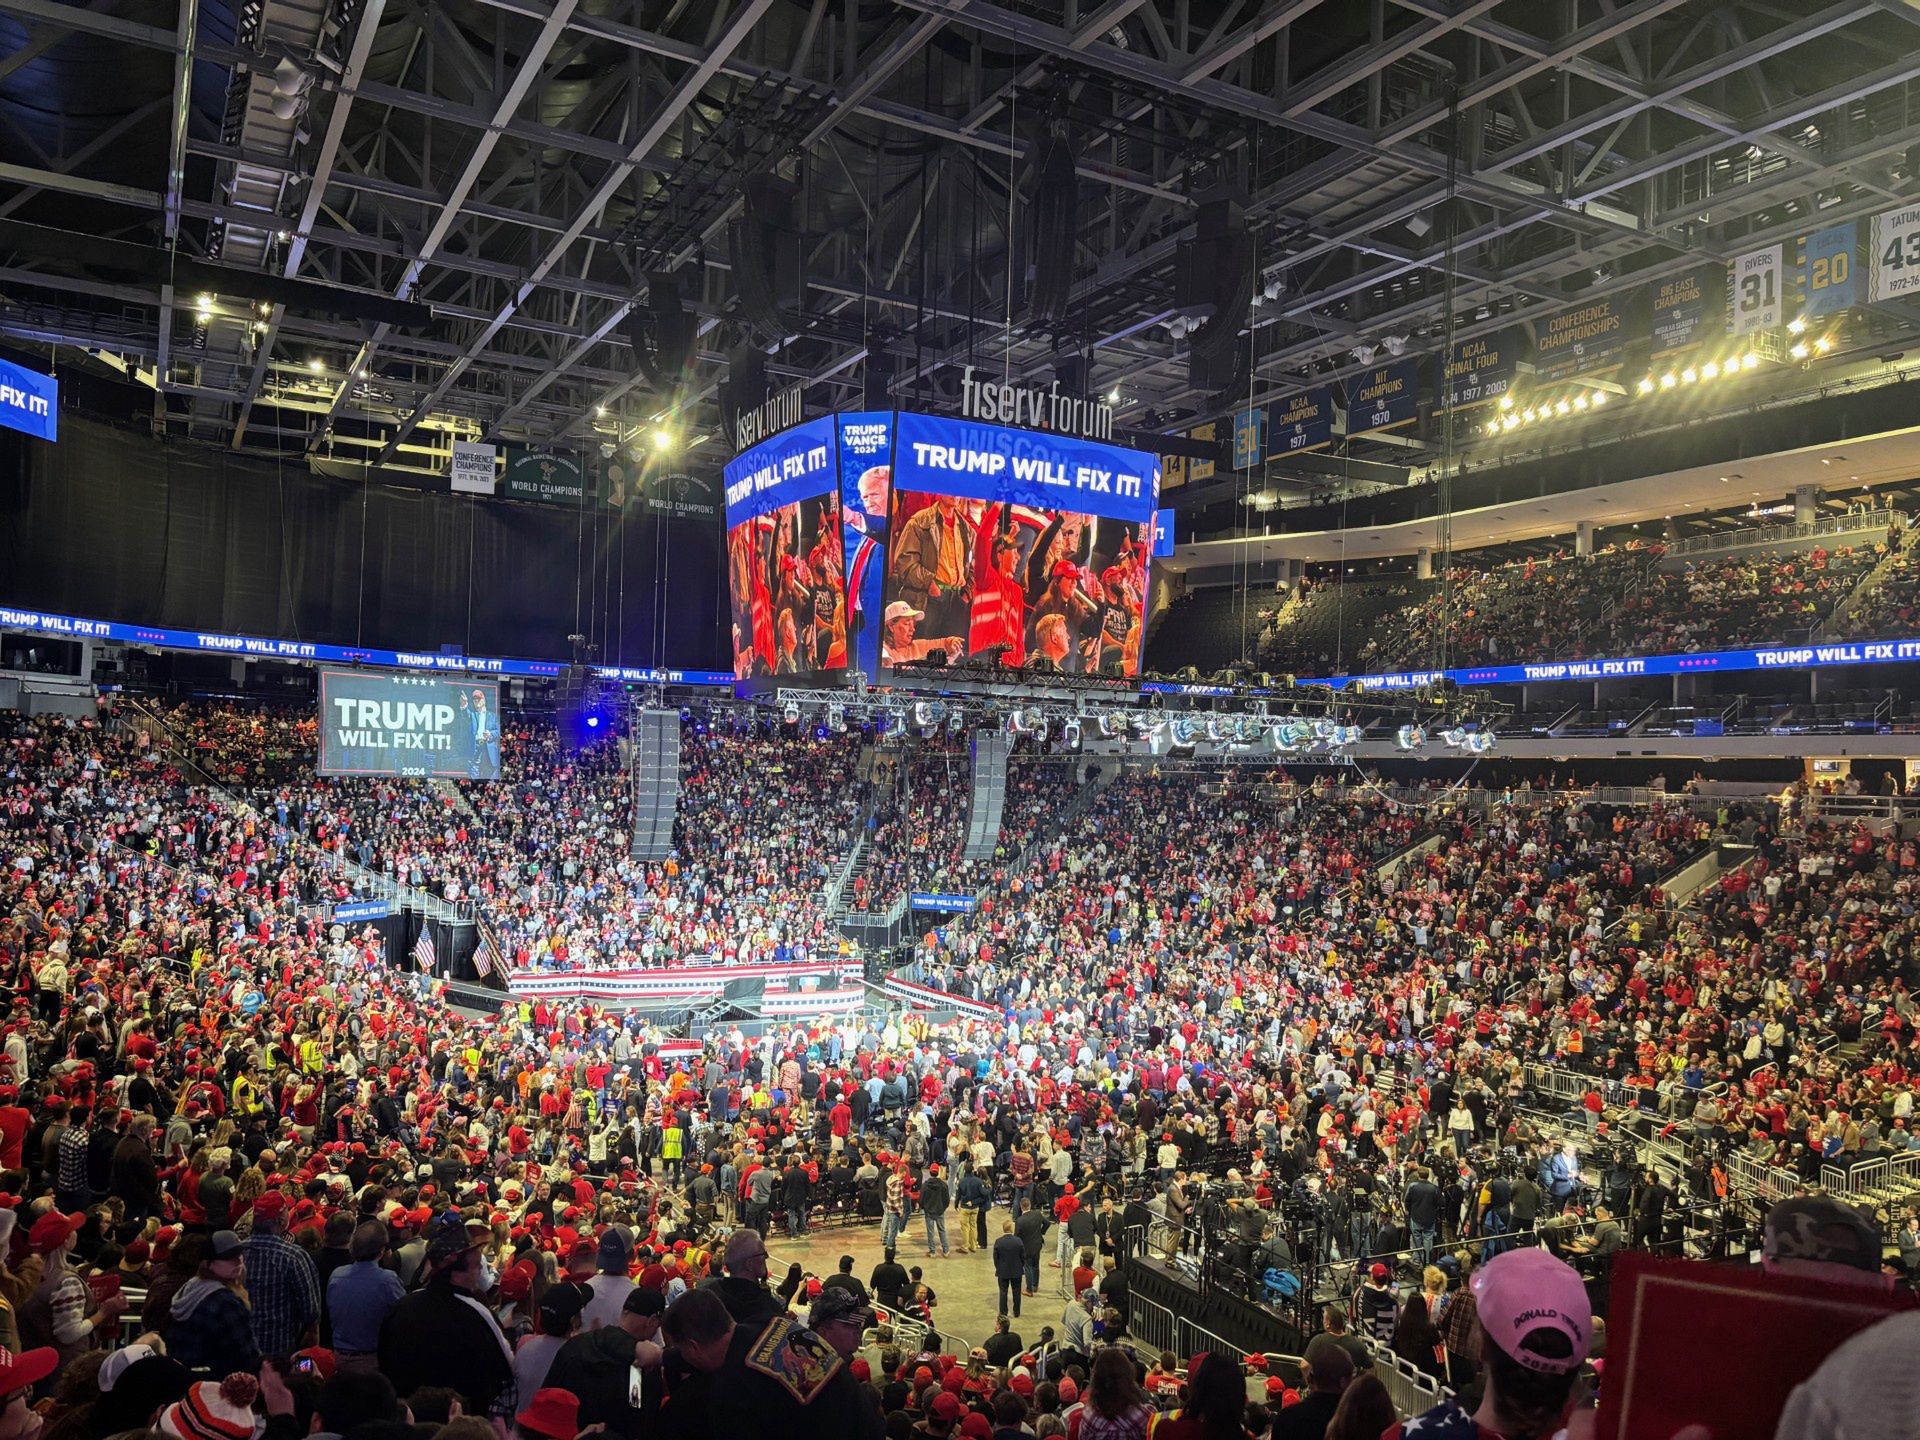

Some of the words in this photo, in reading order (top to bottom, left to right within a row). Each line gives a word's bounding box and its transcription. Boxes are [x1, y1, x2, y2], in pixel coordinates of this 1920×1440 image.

[1890, 210, 1920, 229] TATUM
[1882, 231, 1920, 271] 43
[1744, 253, 1773, 272] RIVERS
[1811, 250, 1849, 291] 20
[1660, 283, 1674, 298] BIG
[1675, 276, 1695, 293] EAST
[1740, 268, 1776, 313] 31
[1889, 274, 1920, 292] 1972-76
[1654, 287, 1700, 310] CHAMPIONS
[1549, 302, 1610, 333] CONFERENCE
[1539, 315, 1620, 351] CHAMPIONSHIPS
[1462, 341, 1487, 358] NCAA
[1450, 359, 1474, 376] FINAL
[1476, 351, 1498, 369] FOUR
[1375, 370, 1388, 384] NIT
[1360, 378, 1403, 401] CHAMPIONS
[1462, 386, 1481, 401] 1977
[1485, 380, 1507, 395] 2003
[0, 384, 26, 410] FIX
[29, 394, 48, 416] IT!
[1289, 395, 1308, 411] NCAA
[1279, 404, 1319, 426] CHAMPIONS
[1371, 410, 1390, 426] 1970
[844, 424, 887, 436] TRUMP
[844, 435, 886, 446] VANCE
[1237, 425, 1257, 455] 31
[1290, 434, 1307, 449] 1977
[455, 452, 495, 465] CONFERENCE
[853, 446, 877, 454] 2024
[455, 461, 492, 473] CHAMPIONS
[913, 442, 1006, 476] TRUMP
[1012, 456, 1072, 487] WILL
[1076, 466, 1112, 493] FIX
[1116, 475, 1141, 498] IT!
[1166, 455, 1180, 475] 14
[727, 475, 753, 507] TRUMP
[754, 463, 782, 492] WILL
[783, 452, 806, 481] FIX
[808, 446, 827, 472] IT!
[511, 480, 538, 492] WORLD
[540, 484, 583, 497] CHAMPIONS
[648, 498, 673, 510] WORLD
[675, 502, 714, 514] CHAMPIONS
[42, 616, 71, 631] WILL
[74, 620, 93, 634] FIX
[95, 624, 110, 635] IT!
[198, 635, 243, 649] TRUMP
[245, 640, 276, 652] WILL
[279, 643, 298, 655] FIX
[301, 645, 315, 656] IT!
[1756, 650, 1814, 665] TRUMP
[1816, 647, 1861, 662] WILL
[1864, 645, 1894, 659] FIX
[1898, 643, 1920, 657] IT!
[396, 654, 434, 665] TRUMP
[436, 657, 466, 668] WILL
[467, 660, 486, 670] FIX
[488, 661, 502, 671] IT!
[1524, 665, 1566, 678] TRUMP
[1569, 663, 1601, 675] WILL
[1603, 662, 1624, 674] FIX
[1627, 660, 1645, 672] IT!
[623, 670, 648, 680] WILL
[1386, 676, 1411, 686] WILL
[1412, 673, 1428, 685] FIX
[334, 697, 455, 732] TRUMP
[338, 729, 388, 748] WILL
[393, 732, 424, 749] FIX
[429, 734, 451, 750] IT!
[402, 767, 426, 776] 2024
[336, 909, 356, 918] TRUMP
[356, 908, 369, 916] WILL
[1890, 1202, 1900, 1221] CITY
[1513, 1308, 1558, 1329] DONALD
[1522, 1355, 1558, 1372] 2024
